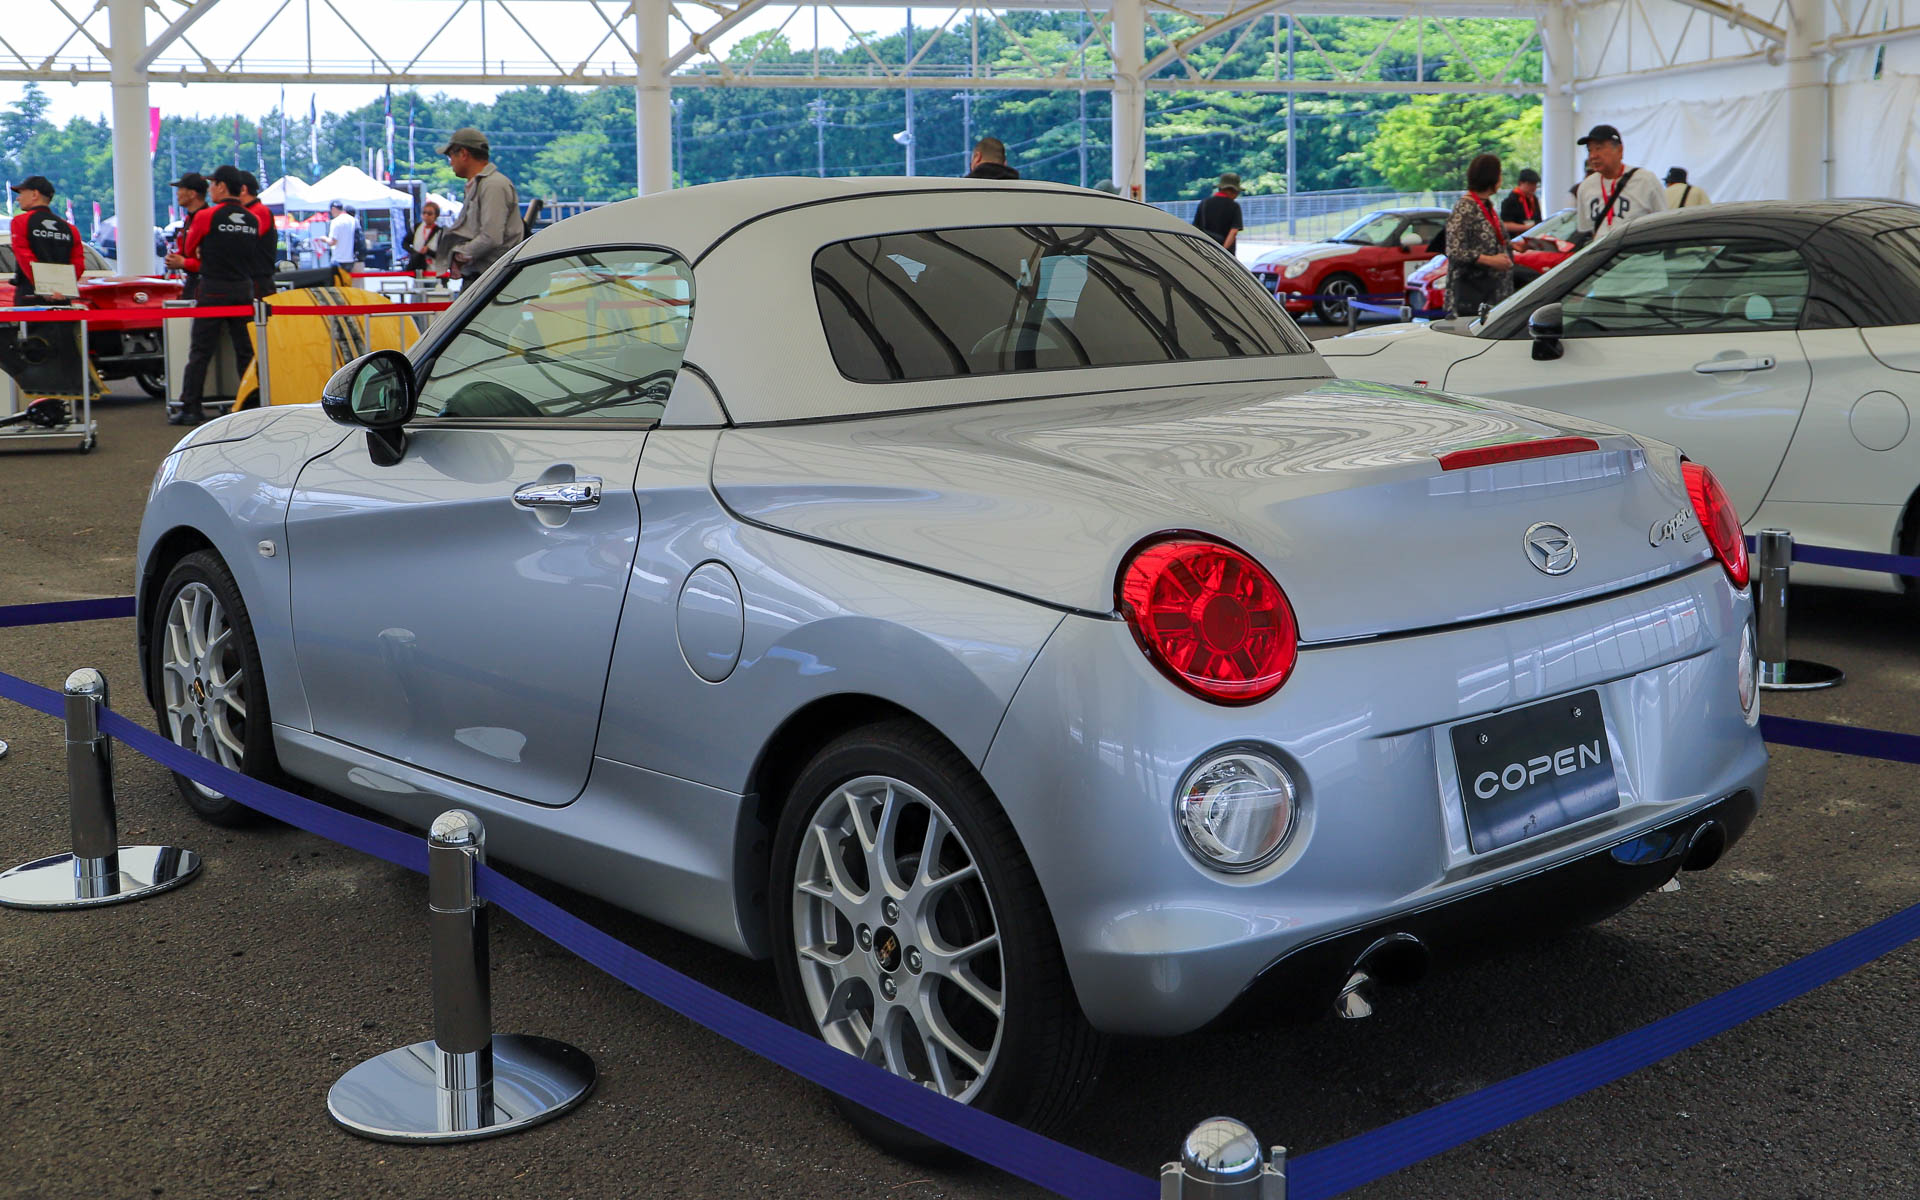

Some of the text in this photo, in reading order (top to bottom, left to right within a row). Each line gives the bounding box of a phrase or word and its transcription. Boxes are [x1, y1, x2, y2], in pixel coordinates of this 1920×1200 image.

[1590, 195, 1630, 221] GP
[32, 229, 71, 241] COPEN
[218, 223, 257, 235] COPEN
[1649, 508, 1692, 548] Copen
[1474, 739, 1601, 799] COPEN
